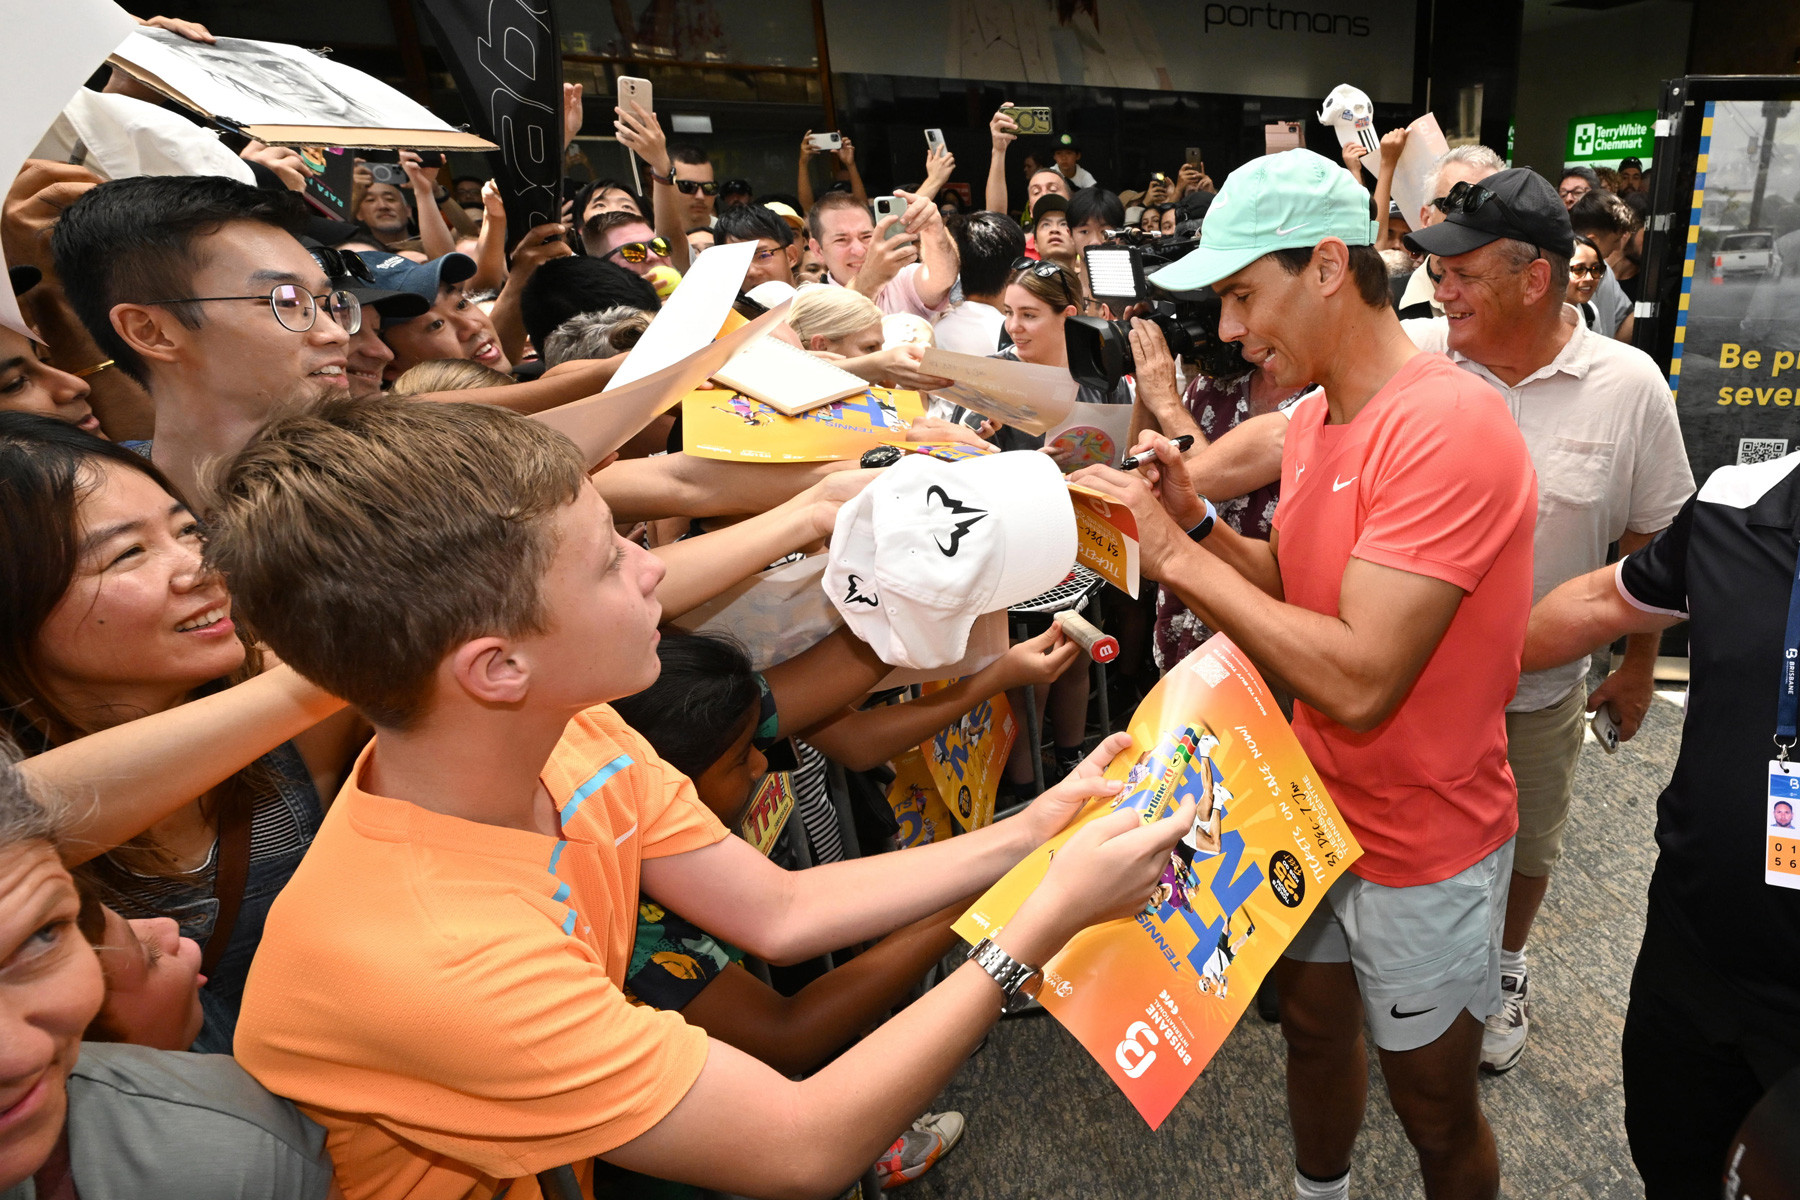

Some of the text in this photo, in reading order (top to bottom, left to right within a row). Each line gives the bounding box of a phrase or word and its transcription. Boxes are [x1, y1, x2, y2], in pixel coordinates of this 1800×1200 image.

[1204, 2, 1370, 37] portmans
[1594, 137, 1643, 151] Chemmart
[1596, 123, 1648, 141] TerryWhite
[1719, 343, 1762, 370] Be
[825, 421, 875, 434] TENNIS
[1107, 543, 1119, 557] 31
[1213, 648, 1267, 716] SCAN TO BUY TICKETS
[1787, 661, 1796, 695] BRISBANE
[1143, 783, 1168, 824] Artline
[1161, 768, 1174, 784] 70
[1159, 771, 1179, 806] PERFORMANCE
[1234, 725, 1326, 885] TICKETS ON SALE NOW!
[747, 772, 784, 846] TFH
[1301, 774, 1349, 856] TENNIS CENTRE
[1303, 790, 1344, 859] QUEENSLAND
[1324, 851, 1340, 867] 31
[1774, 857, 1797, 868] 5 6
[1775, 842, 1796, 854] 0 1
[1135, 911, 1182, 973] TENNIS
[1145, 1003, 1192, 1066] BRISBANE
[1153, 998, 1190, 1048] INTERNATIONAL
